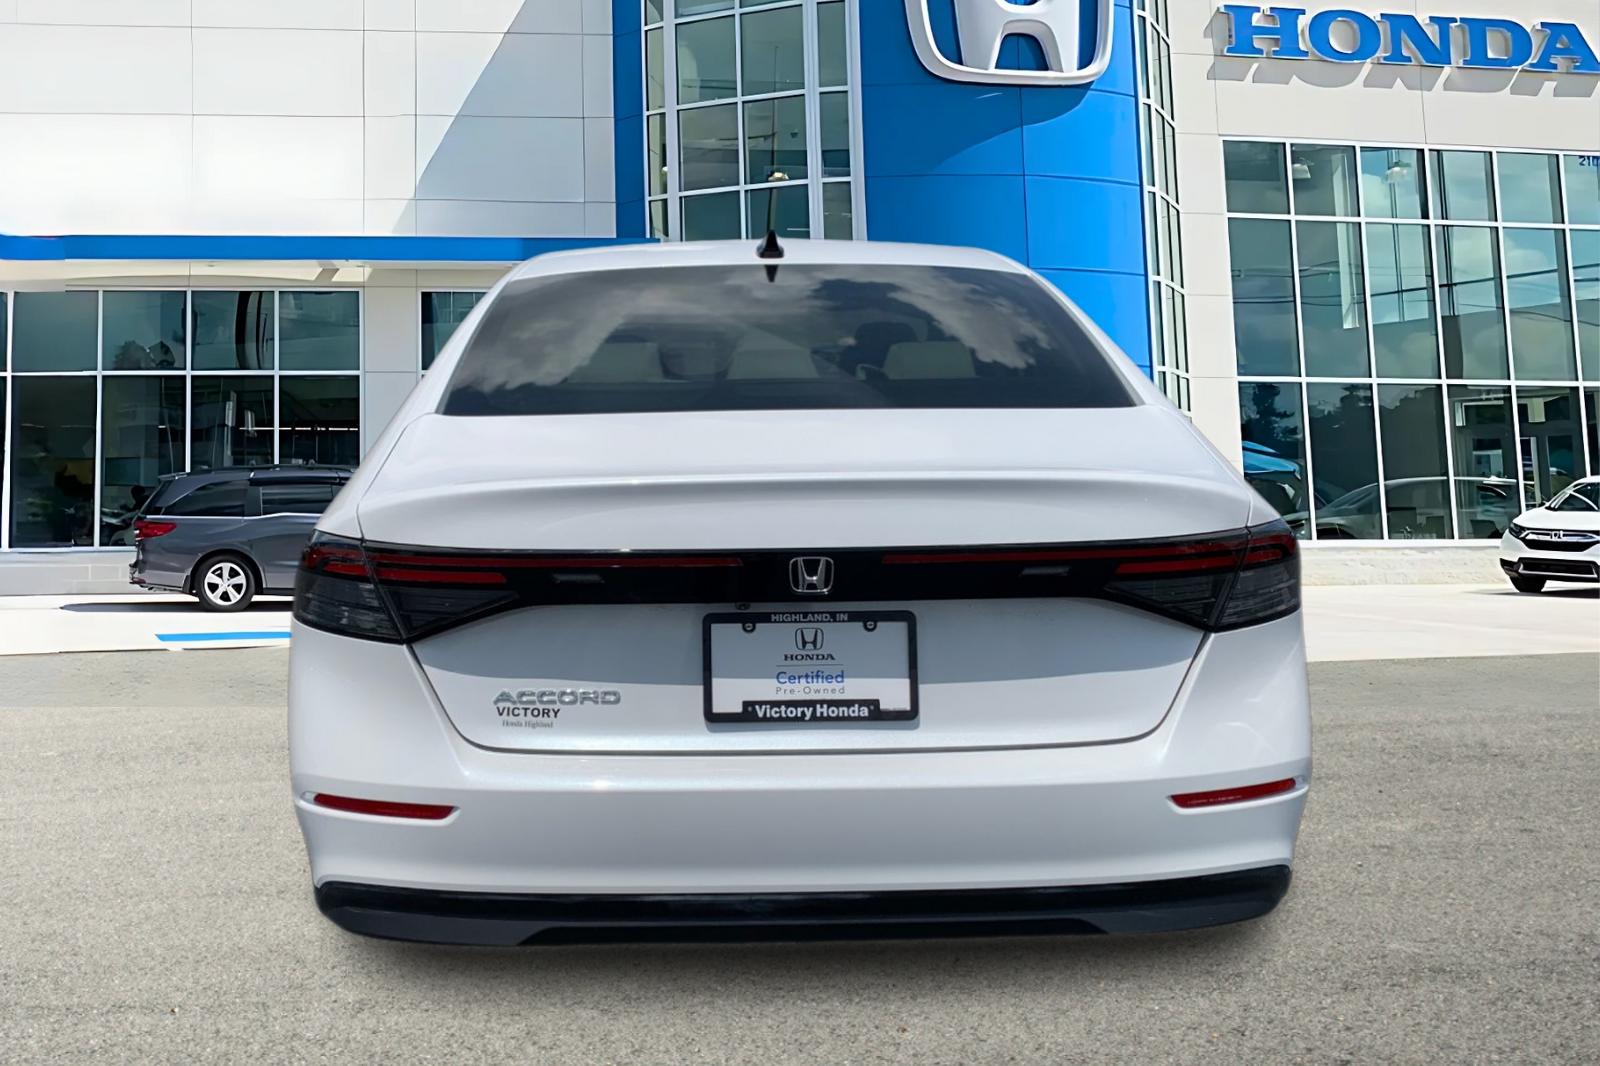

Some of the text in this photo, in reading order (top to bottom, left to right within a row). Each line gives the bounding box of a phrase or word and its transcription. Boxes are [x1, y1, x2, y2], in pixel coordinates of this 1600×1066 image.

[1222, 3, 1600, 74] HONDA
[836, 612, 848, 621] IN
[783, 653, 836, 661] HONDA
[776, 670, 845, 684] Certified
[775, 686, 845, 695] Pre-Owned
[493, 690, 621, 706] ACCORD
[496, 706, 560, 718] VICTORY
[755, 704, 869, 720] Victory Honda
